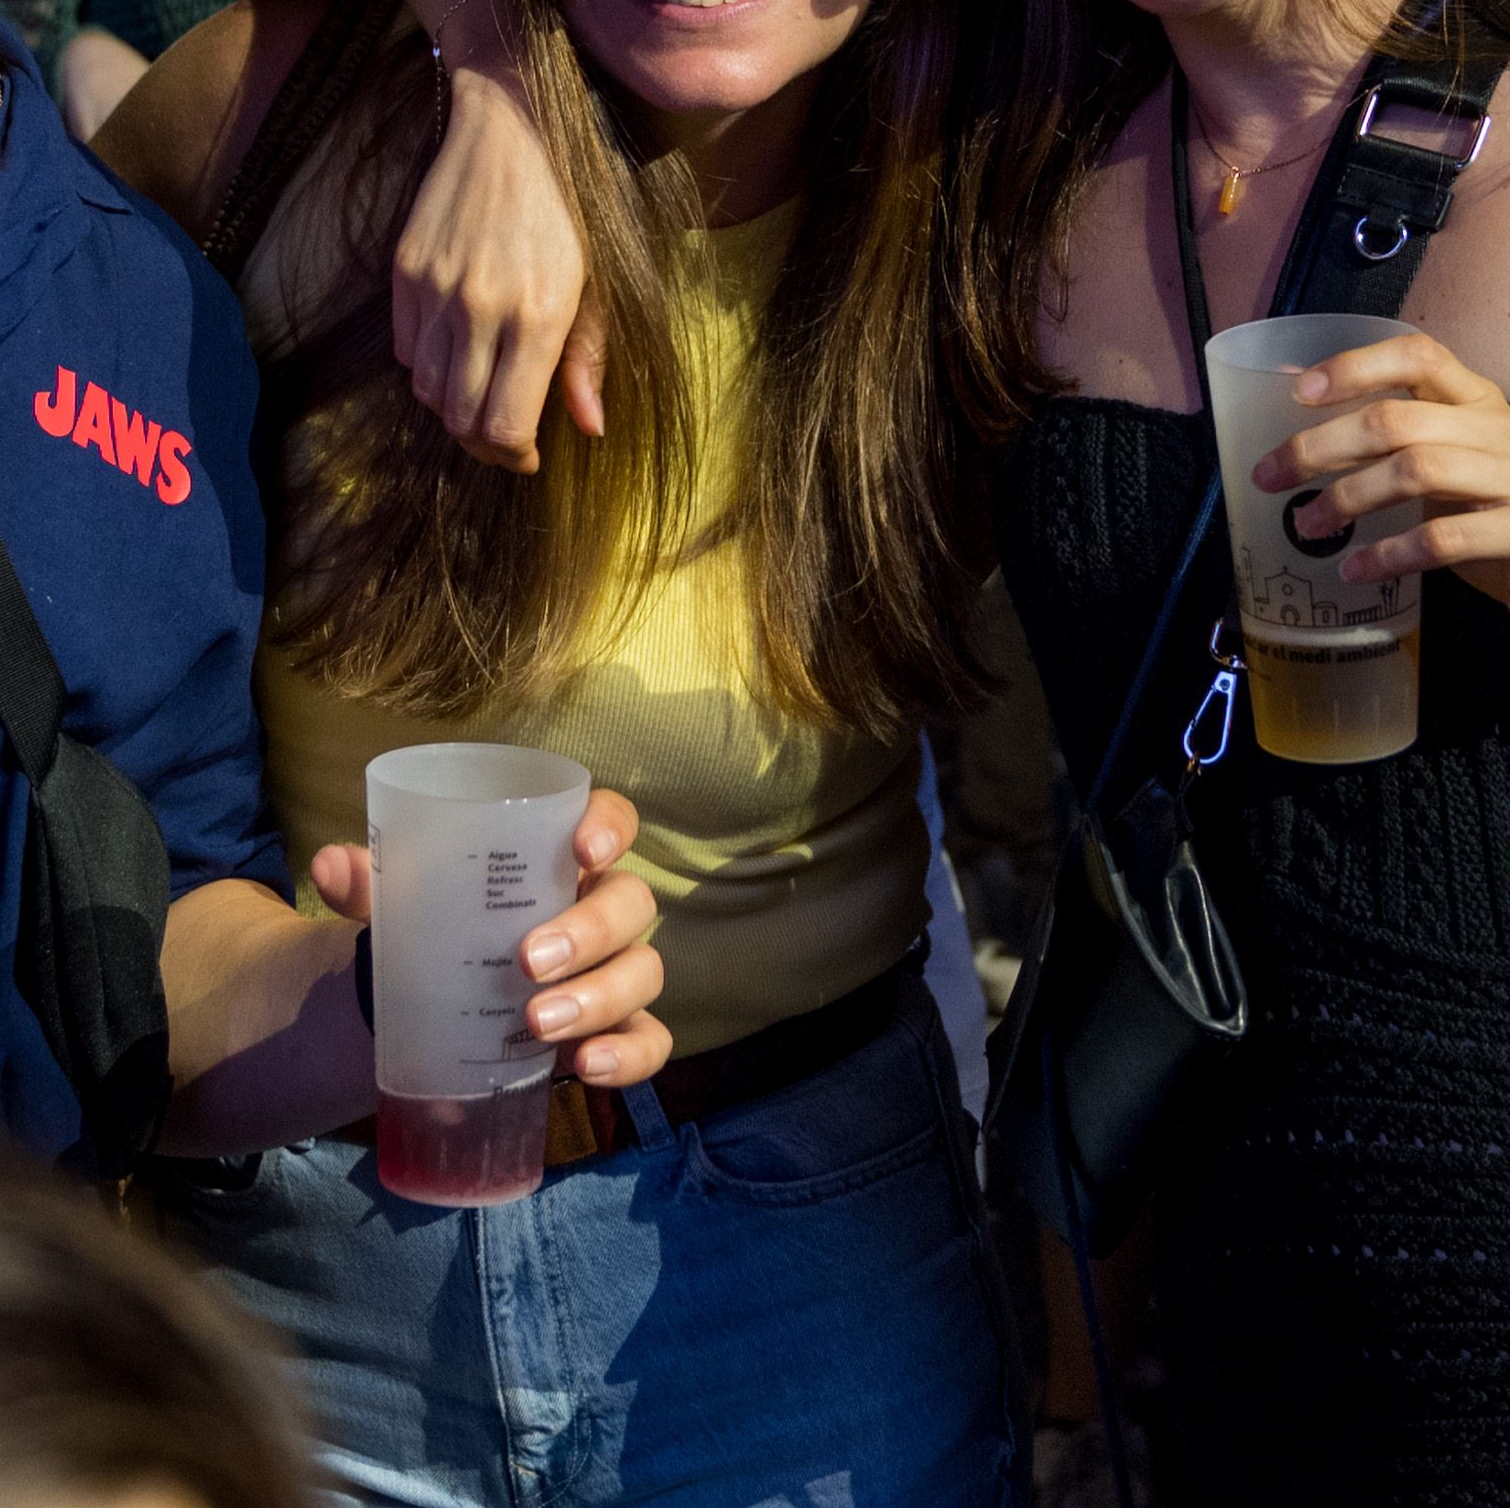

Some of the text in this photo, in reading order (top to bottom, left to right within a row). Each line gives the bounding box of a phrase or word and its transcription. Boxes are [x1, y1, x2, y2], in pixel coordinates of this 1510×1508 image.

[32, 363, 193, 506] JAWS
[1290, 649, 1331, 663] medi
[1337, 638, 1401, 662] ambient
[488, 851, 518, 861] Aigua
[487, 863, 528, 872] Cervesa
[486, 888, 504, 897] Suc
[485, 898, 536, 909] Combinats
[482, 956, 513, 967] Mojito
